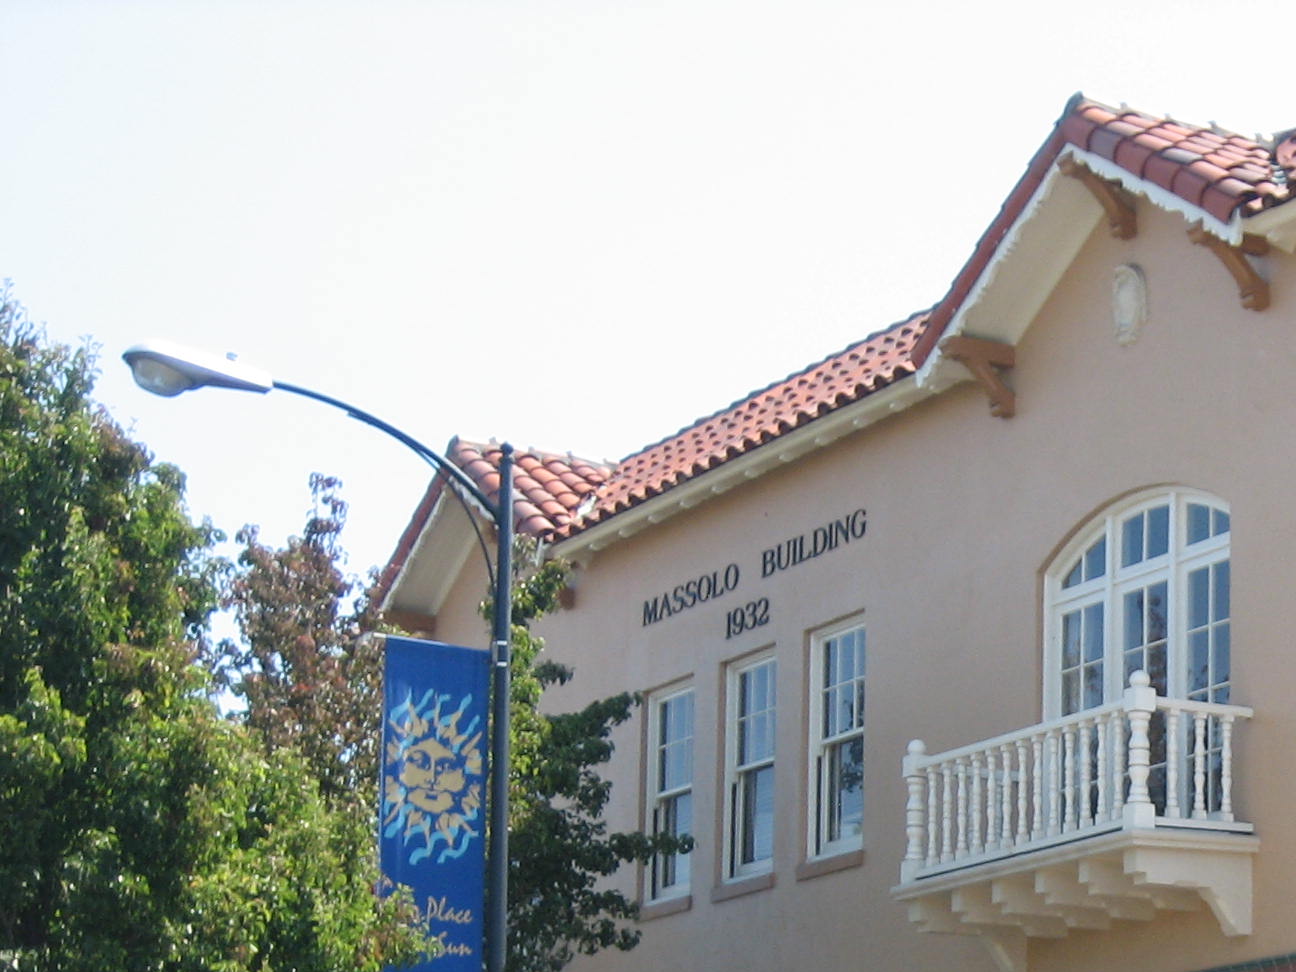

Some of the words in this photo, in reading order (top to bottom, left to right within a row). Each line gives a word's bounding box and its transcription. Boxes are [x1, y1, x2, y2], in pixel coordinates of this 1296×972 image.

[642, 563, 740, 626] MASSOLO
[761, 508, 867, 578] BUILDING
[725, 597, 770, 640] 1932
[427, 896, 473, 925] Place
[434, 931, 472, 957] Sun
